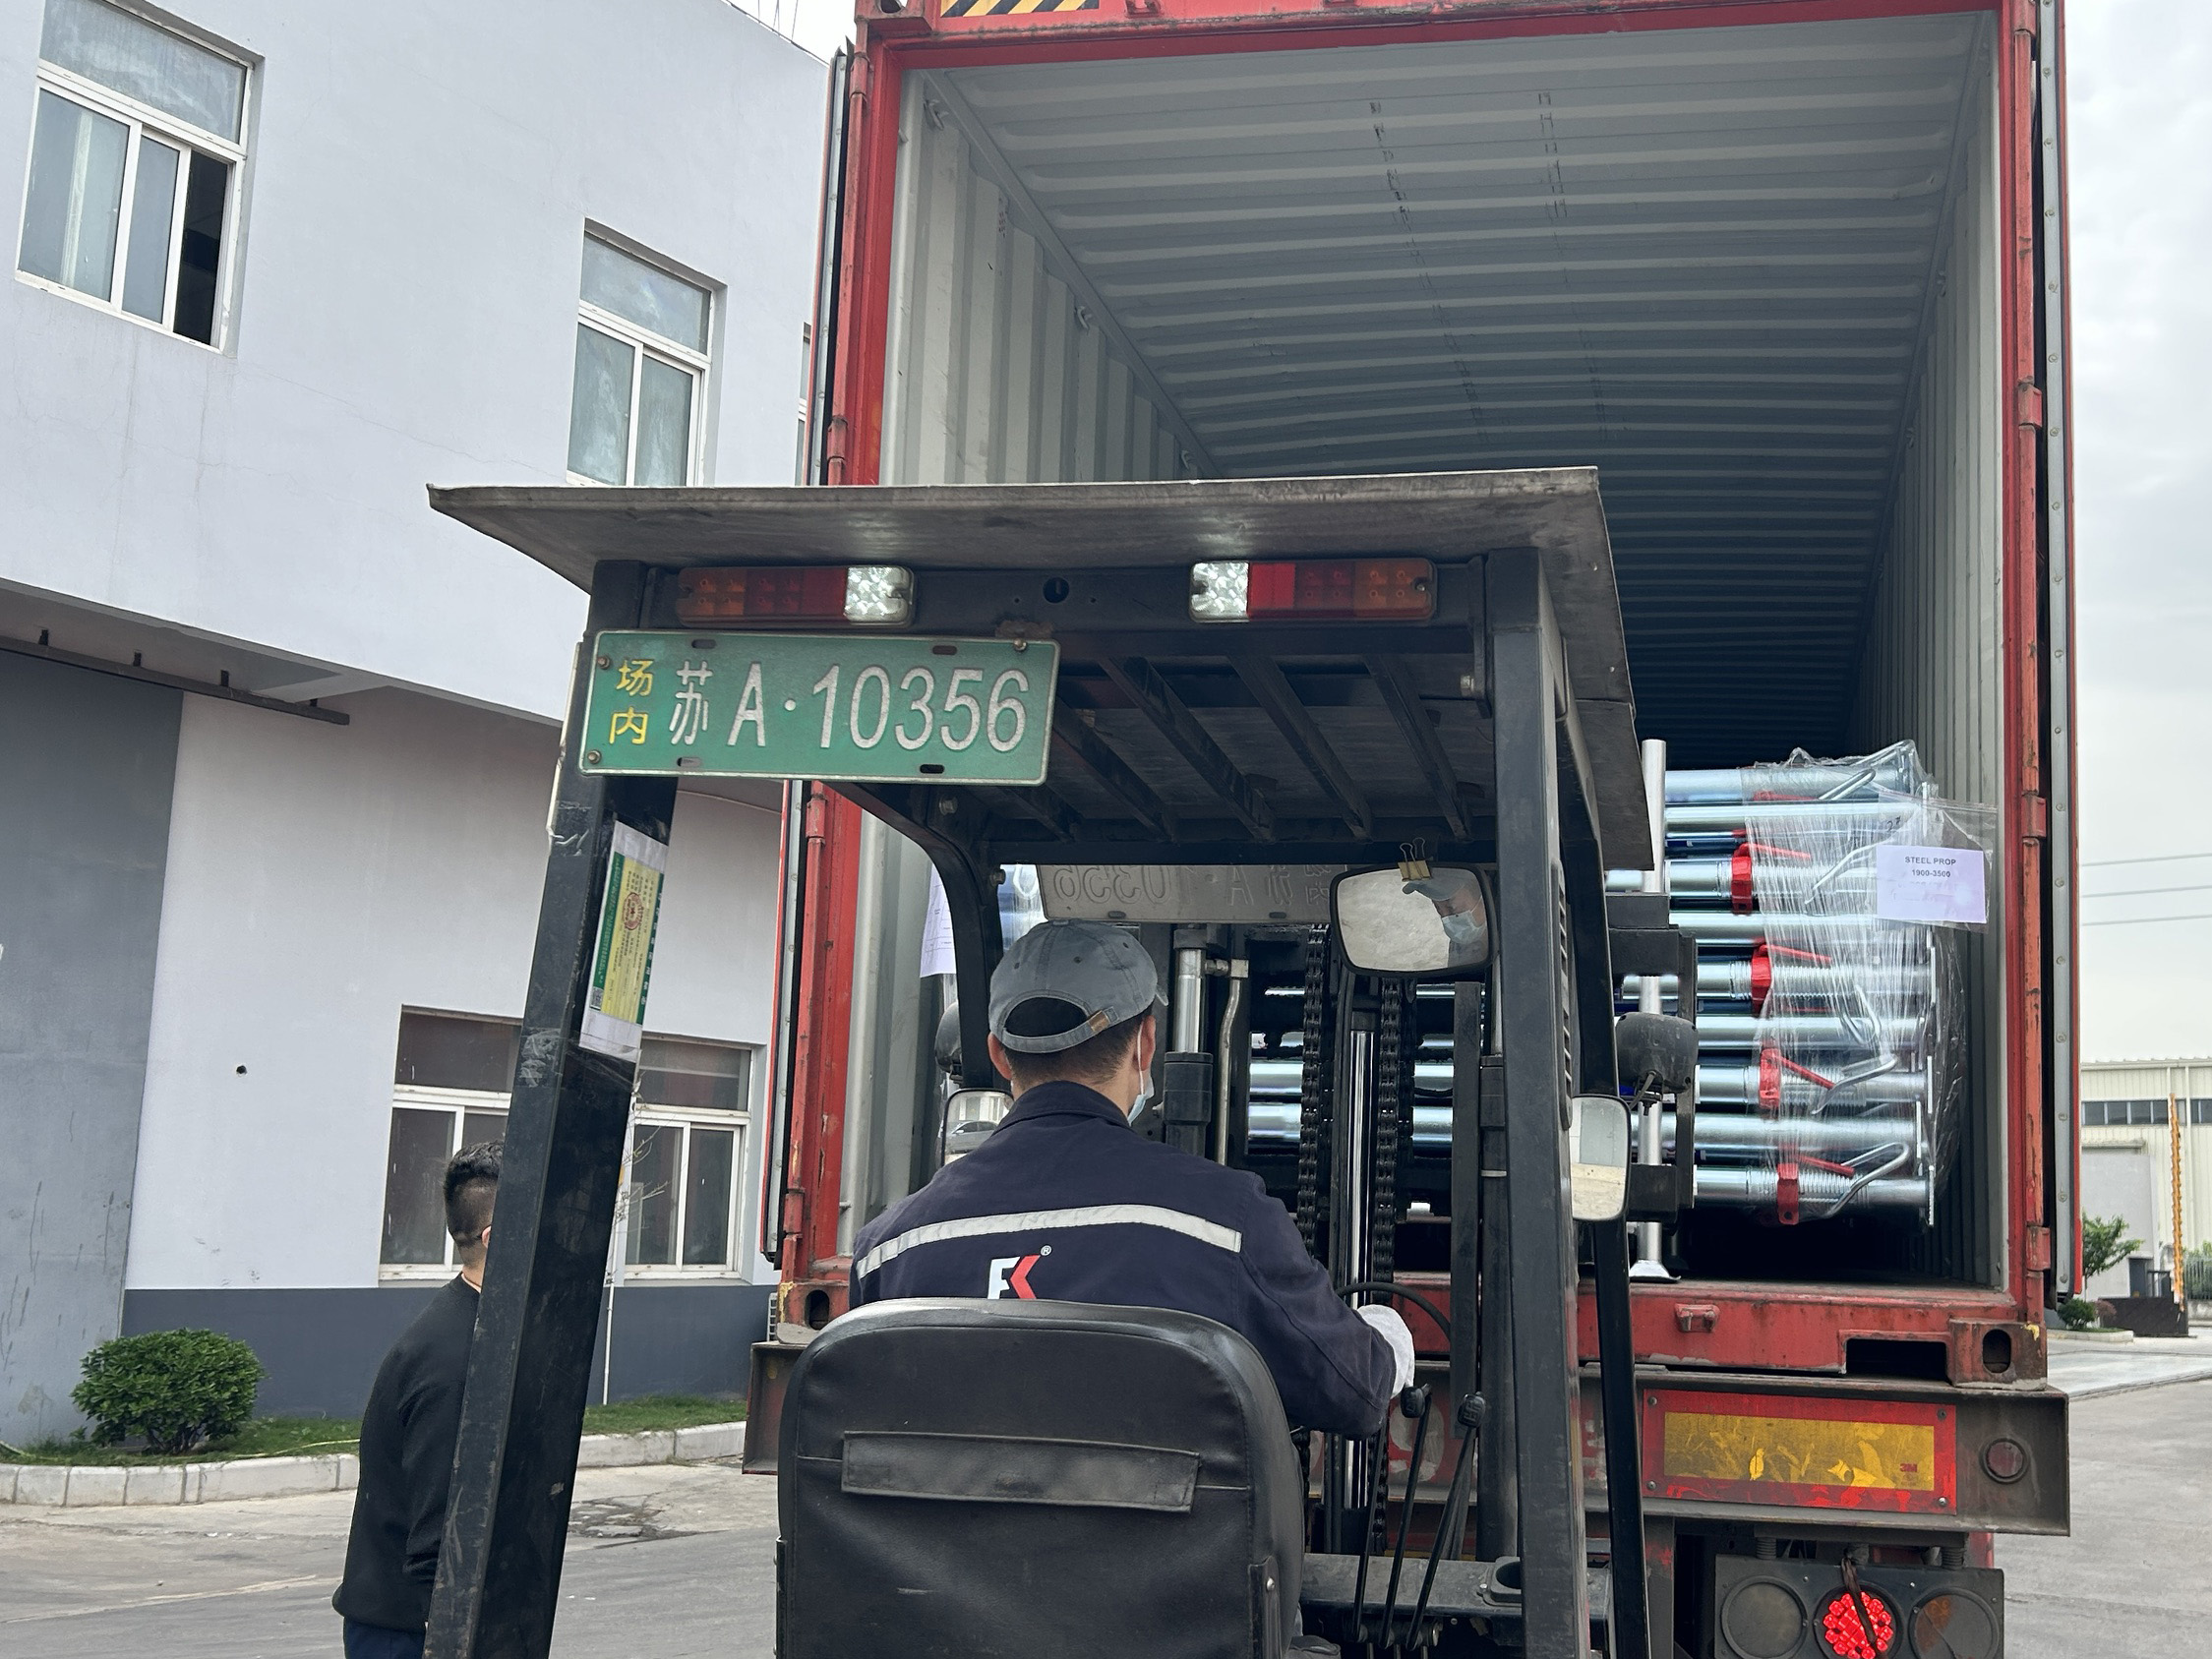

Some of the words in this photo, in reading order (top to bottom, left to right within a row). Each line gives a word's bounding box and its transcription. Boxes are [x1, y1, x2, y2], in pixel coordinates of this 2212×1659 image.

[609, 659, 655, 745] 场内
[1905, 856, 1931, 864] STEEL
[1912, 869, 1951, 878] 1900-3500
